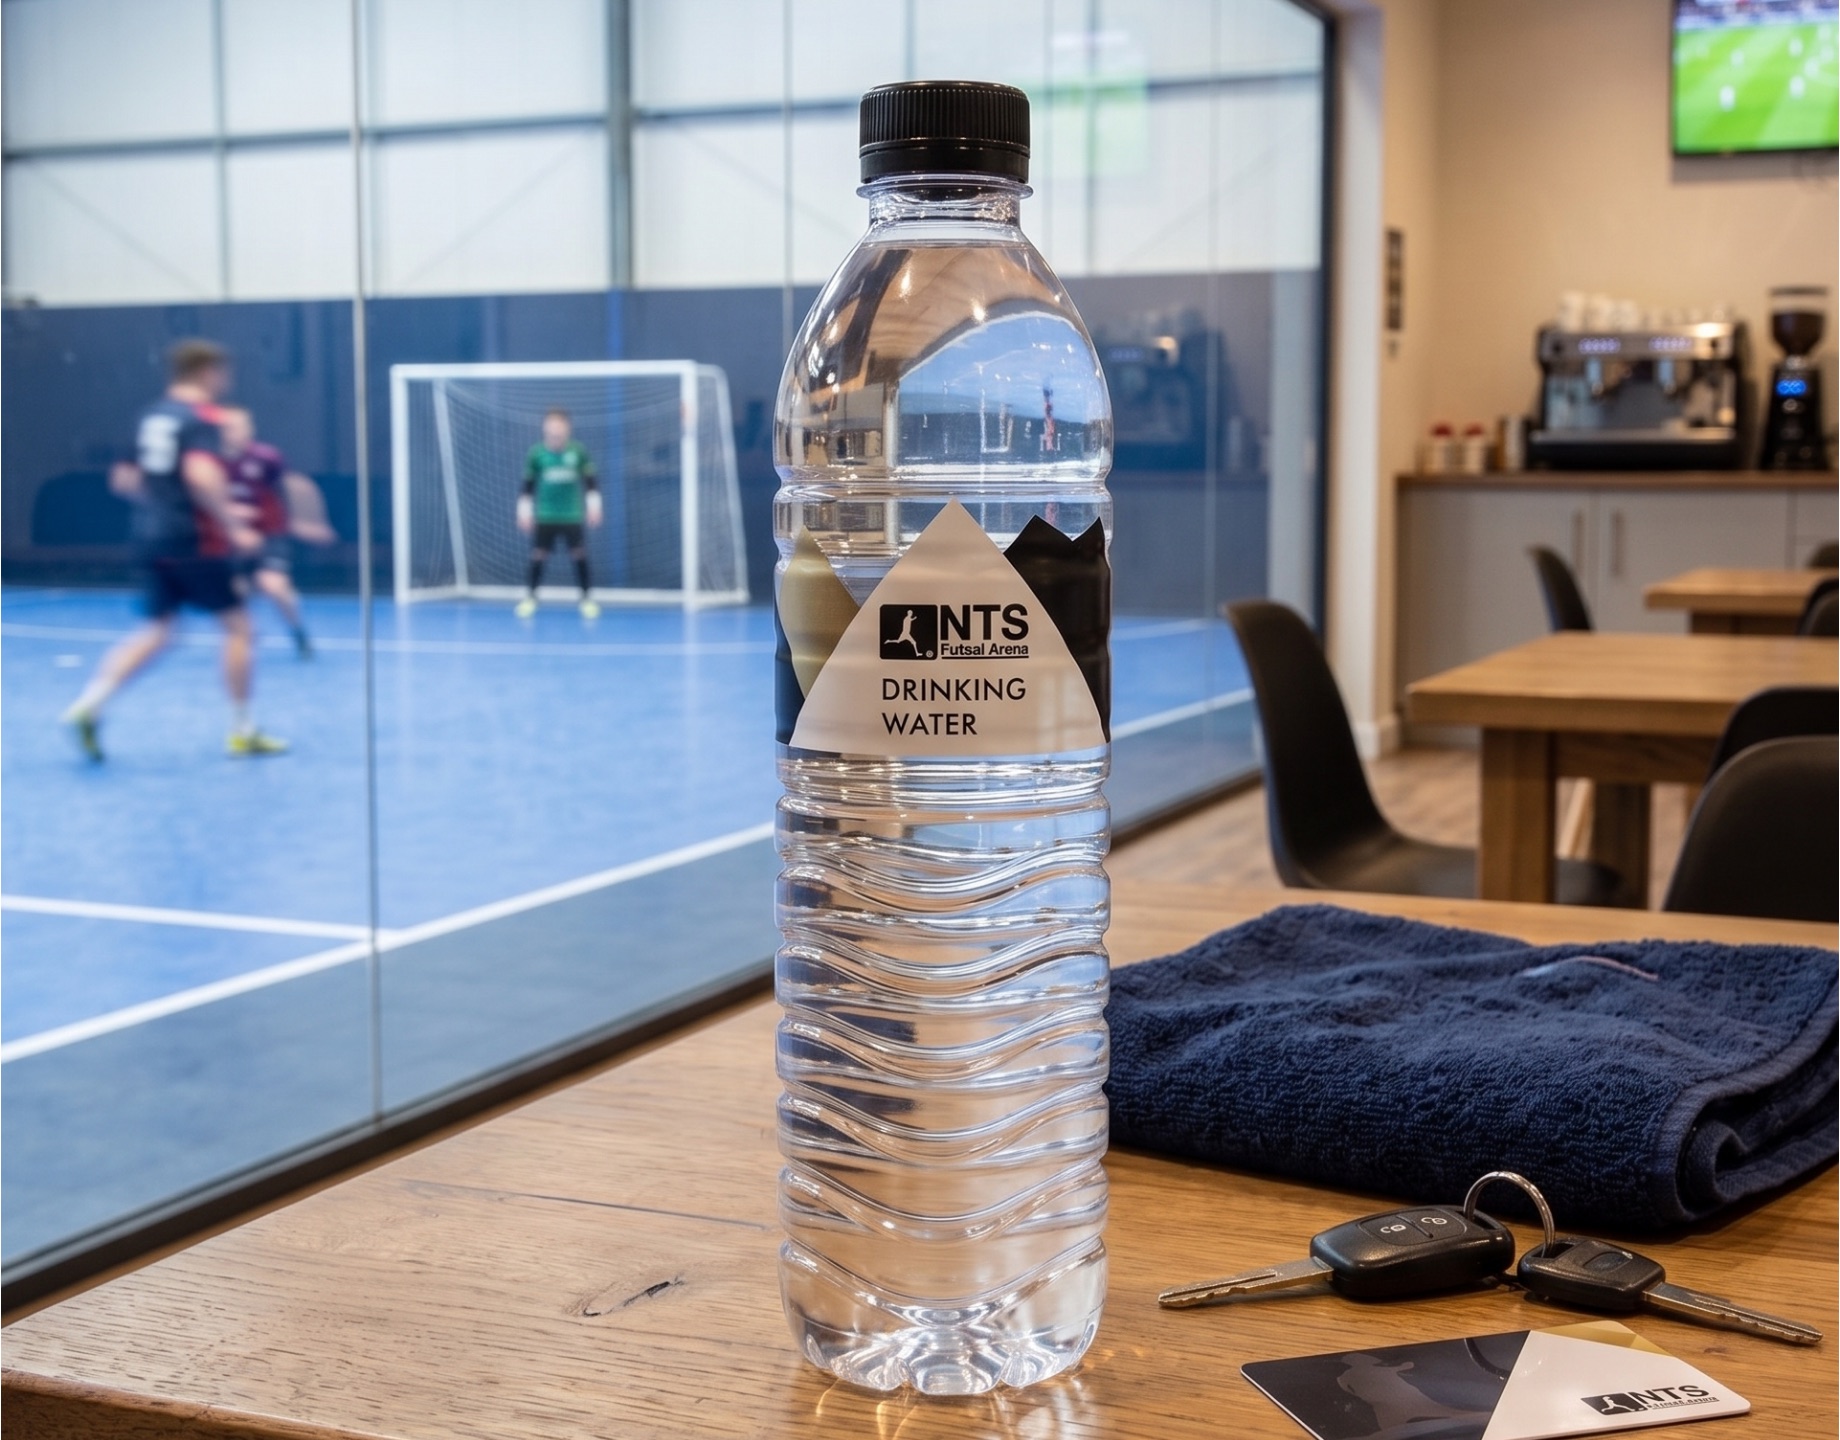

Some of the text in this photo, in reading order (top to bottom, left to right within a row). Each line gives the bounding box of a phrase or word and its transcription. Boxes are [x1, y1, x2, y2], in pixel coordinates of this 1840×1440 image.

[940, 603, 1029, 641] NTS
[940, 643, 1029, 656] Futsal Arena
[882, 677, 1026, 701] DRINKING
[881, 712, 978, 736] WATER
[1629, 1384, 1710, 1405] NTS
